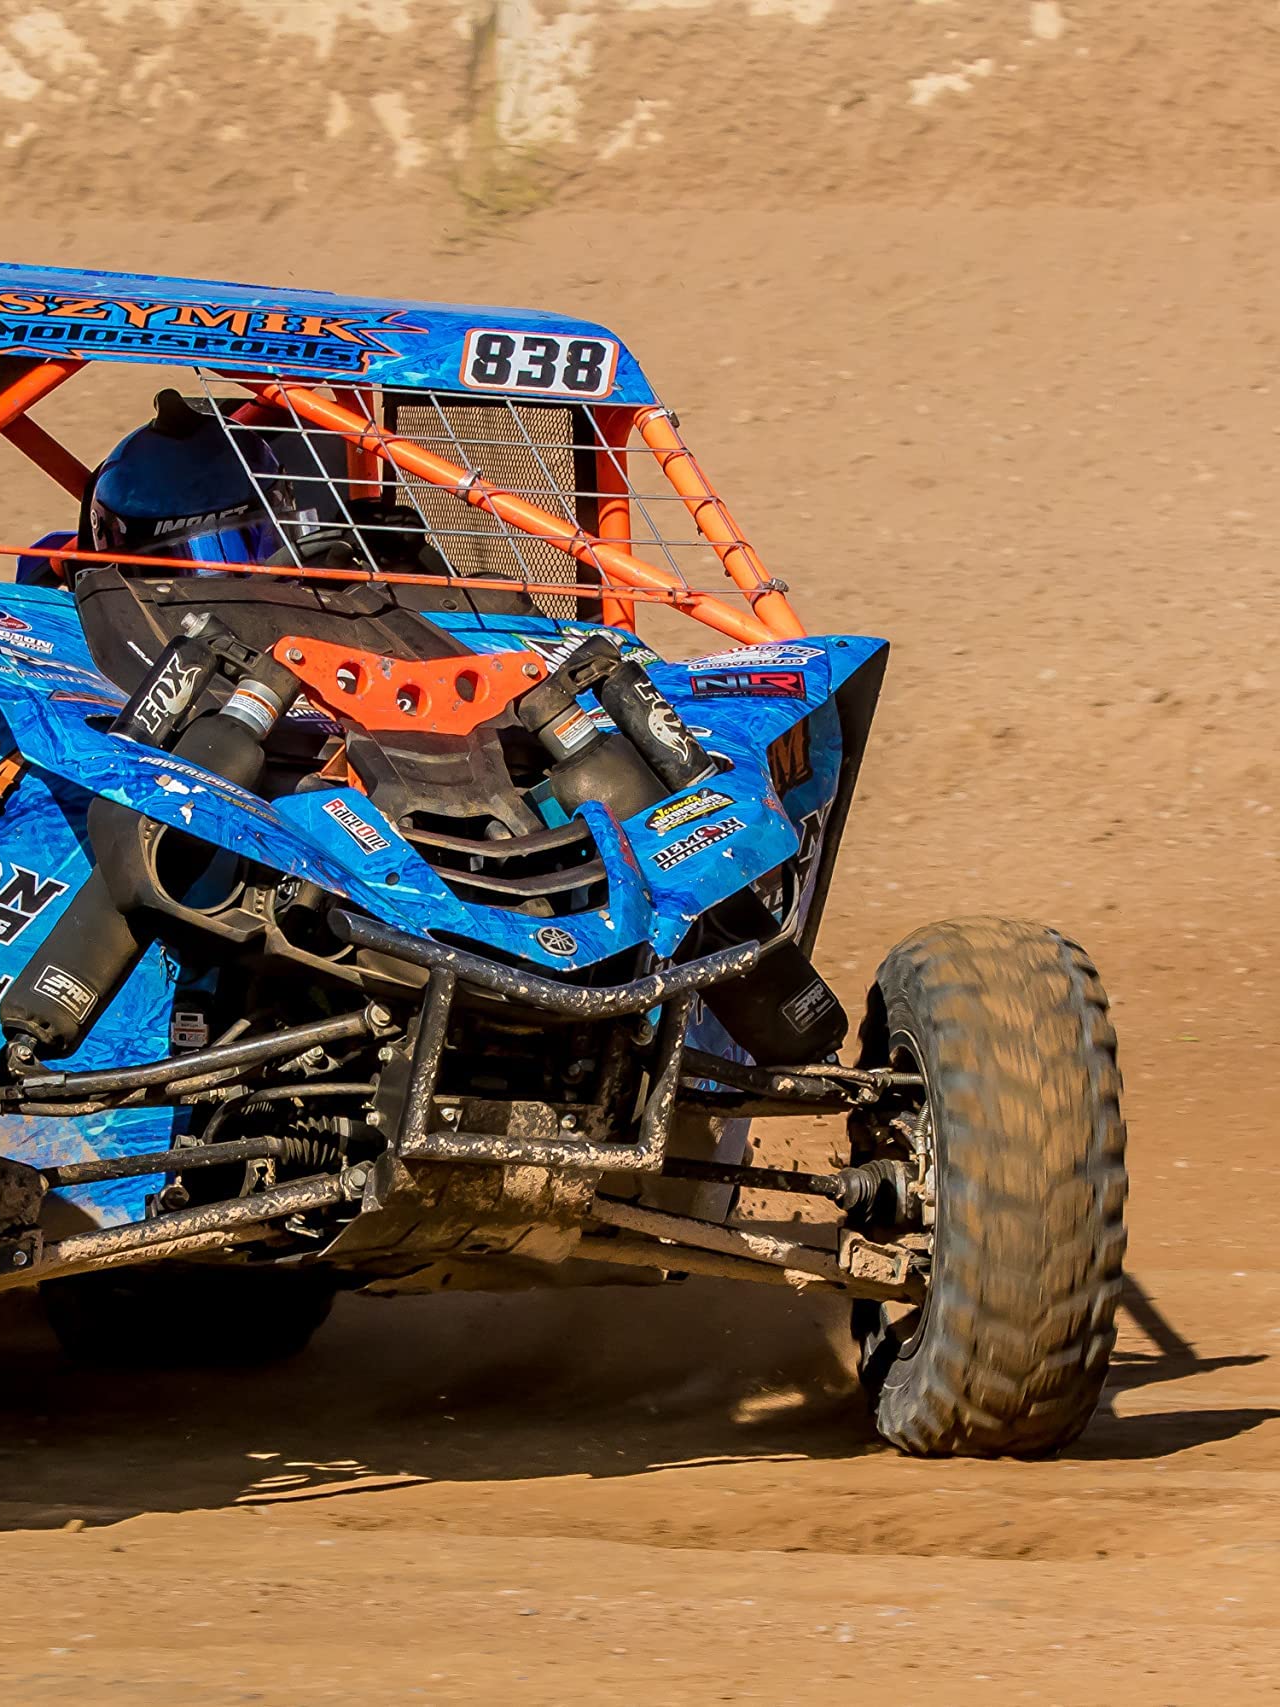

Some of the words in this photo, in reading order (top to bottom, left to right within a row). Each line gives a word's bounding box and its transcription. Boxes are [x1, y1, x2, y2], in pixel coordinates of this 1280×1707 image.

[471, 333, 607, 392] 838
[133, 652, 202, 735] FOX
[695, 673, 800, 693] NLR
[650, 817, 745, 864] DEMON
